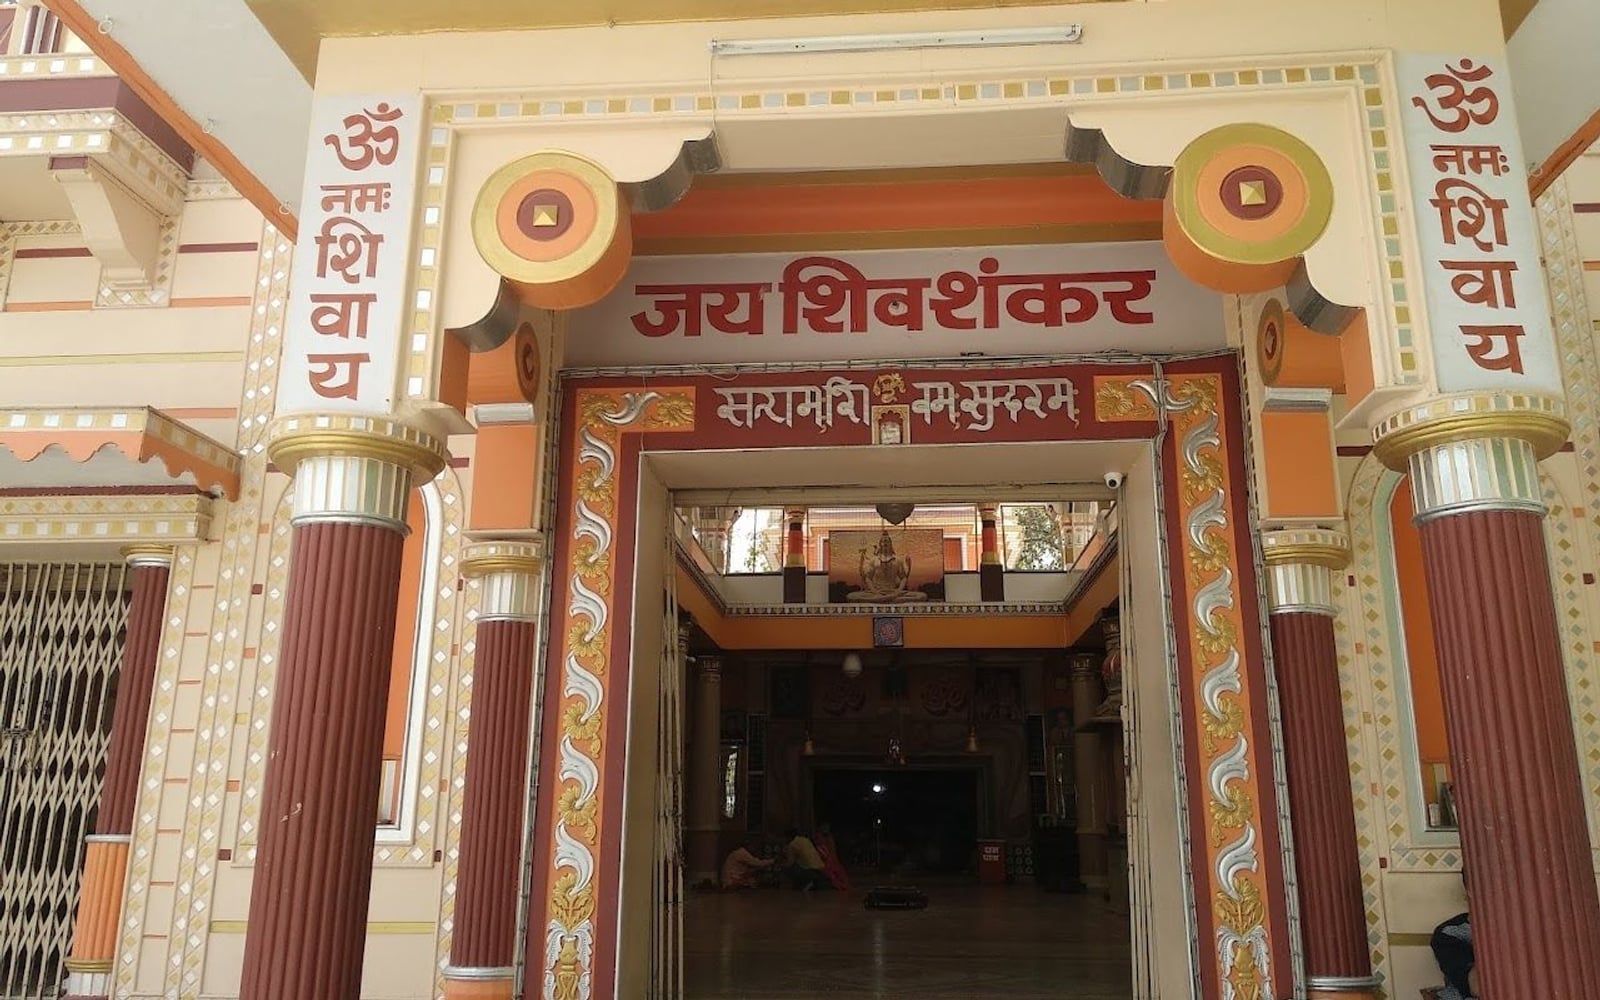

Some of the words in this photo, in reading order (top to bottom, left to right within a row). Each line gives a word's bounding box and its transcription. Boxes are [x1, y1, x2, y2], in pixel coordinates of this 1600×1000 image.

[1411, 58, 1499, 133] ॐ
[323, 102, 404, 171] ॐ
[1428, 144, 1510, 176] नमः
[319, 182, 391, 213] नमः
[629, 281, 773, 336] जय
